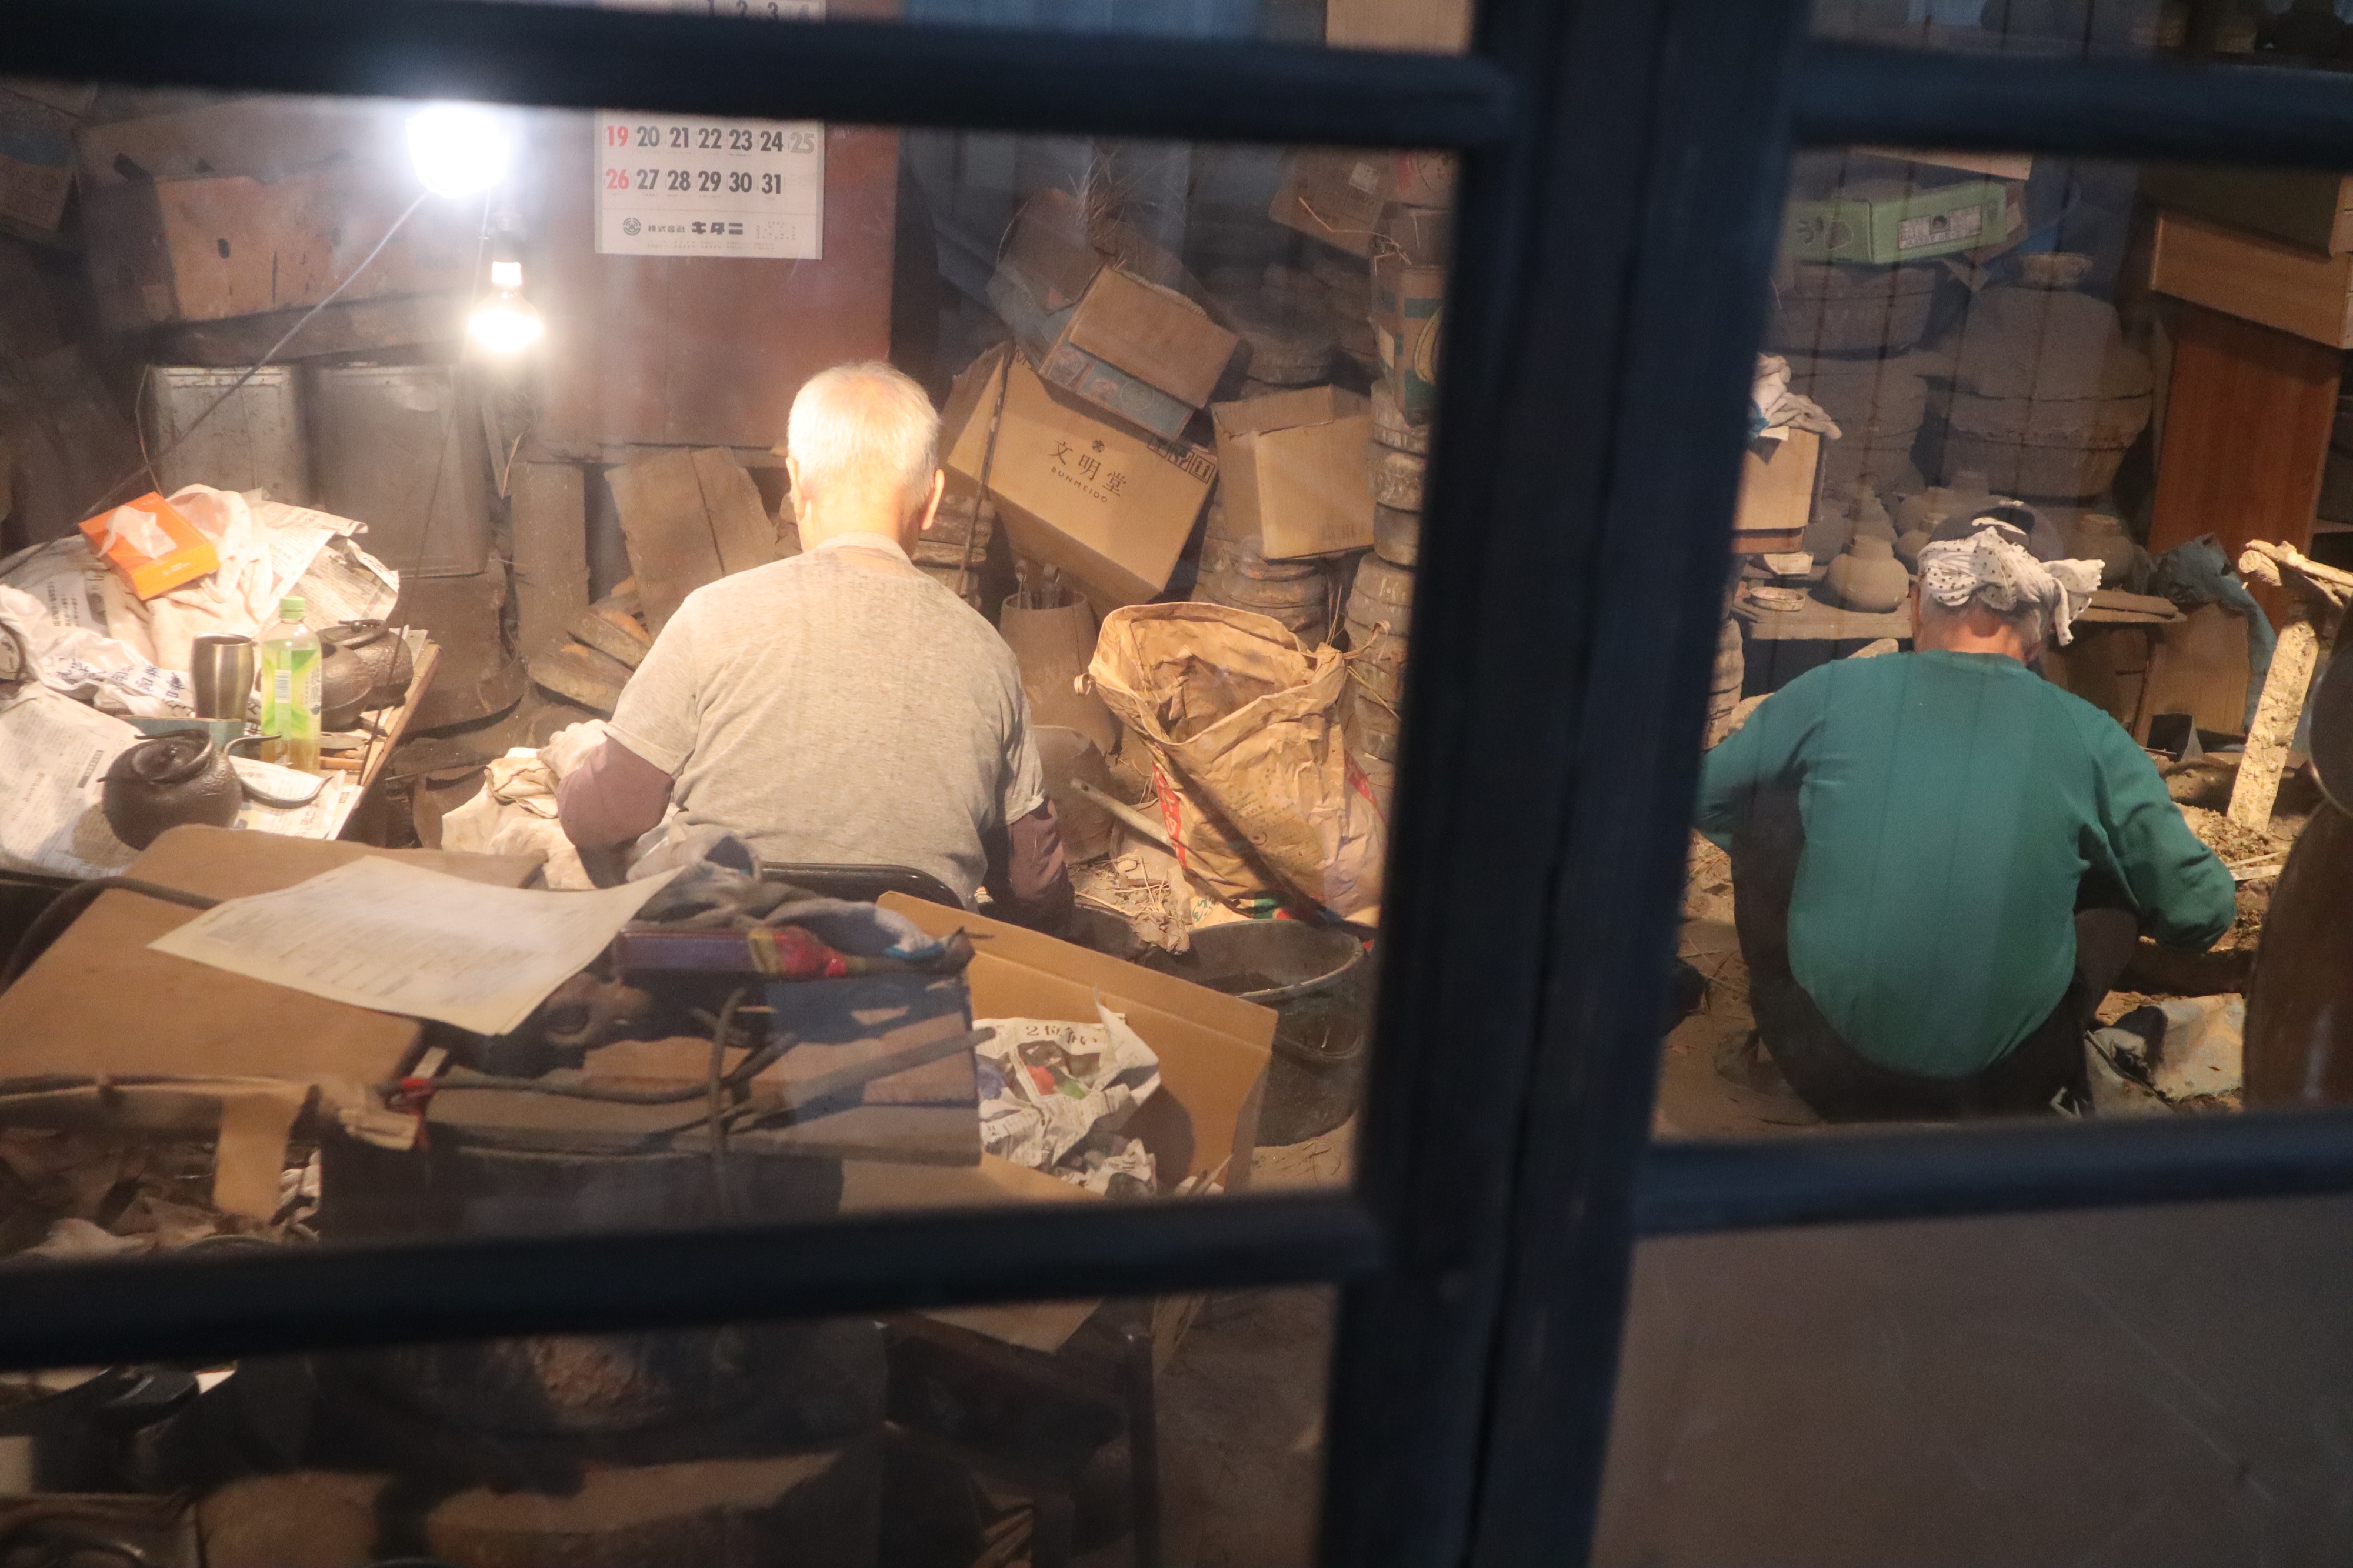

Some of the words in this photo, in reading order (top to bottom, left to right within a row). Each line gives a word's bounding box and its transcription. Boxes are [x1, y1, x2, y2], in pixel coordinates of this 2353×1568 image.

[768, 2, 779, 21] 3
[607, 126, 628, 146] 19
[637, 126, 660, 147] 20
[669, 127, 689, 148] 21
[698, 128, 722, 149] 22
[729, 129, 753, 151] 23
[760, 131, 784, 152] 24
[791, 132, 814, 154] 25
[606, 169, 629, 189] 26
[636, 169, 660, 189] 27
[667, 170, 691, 191] 28
[698, 171, 721, 191] 29
[729, 172, 752, 193] 30
[762, 173, 781, 194] 31
[1048, 440, 1127, 497] 文明堂
[1051, 466, 1108, 502] BUNMEIDO
